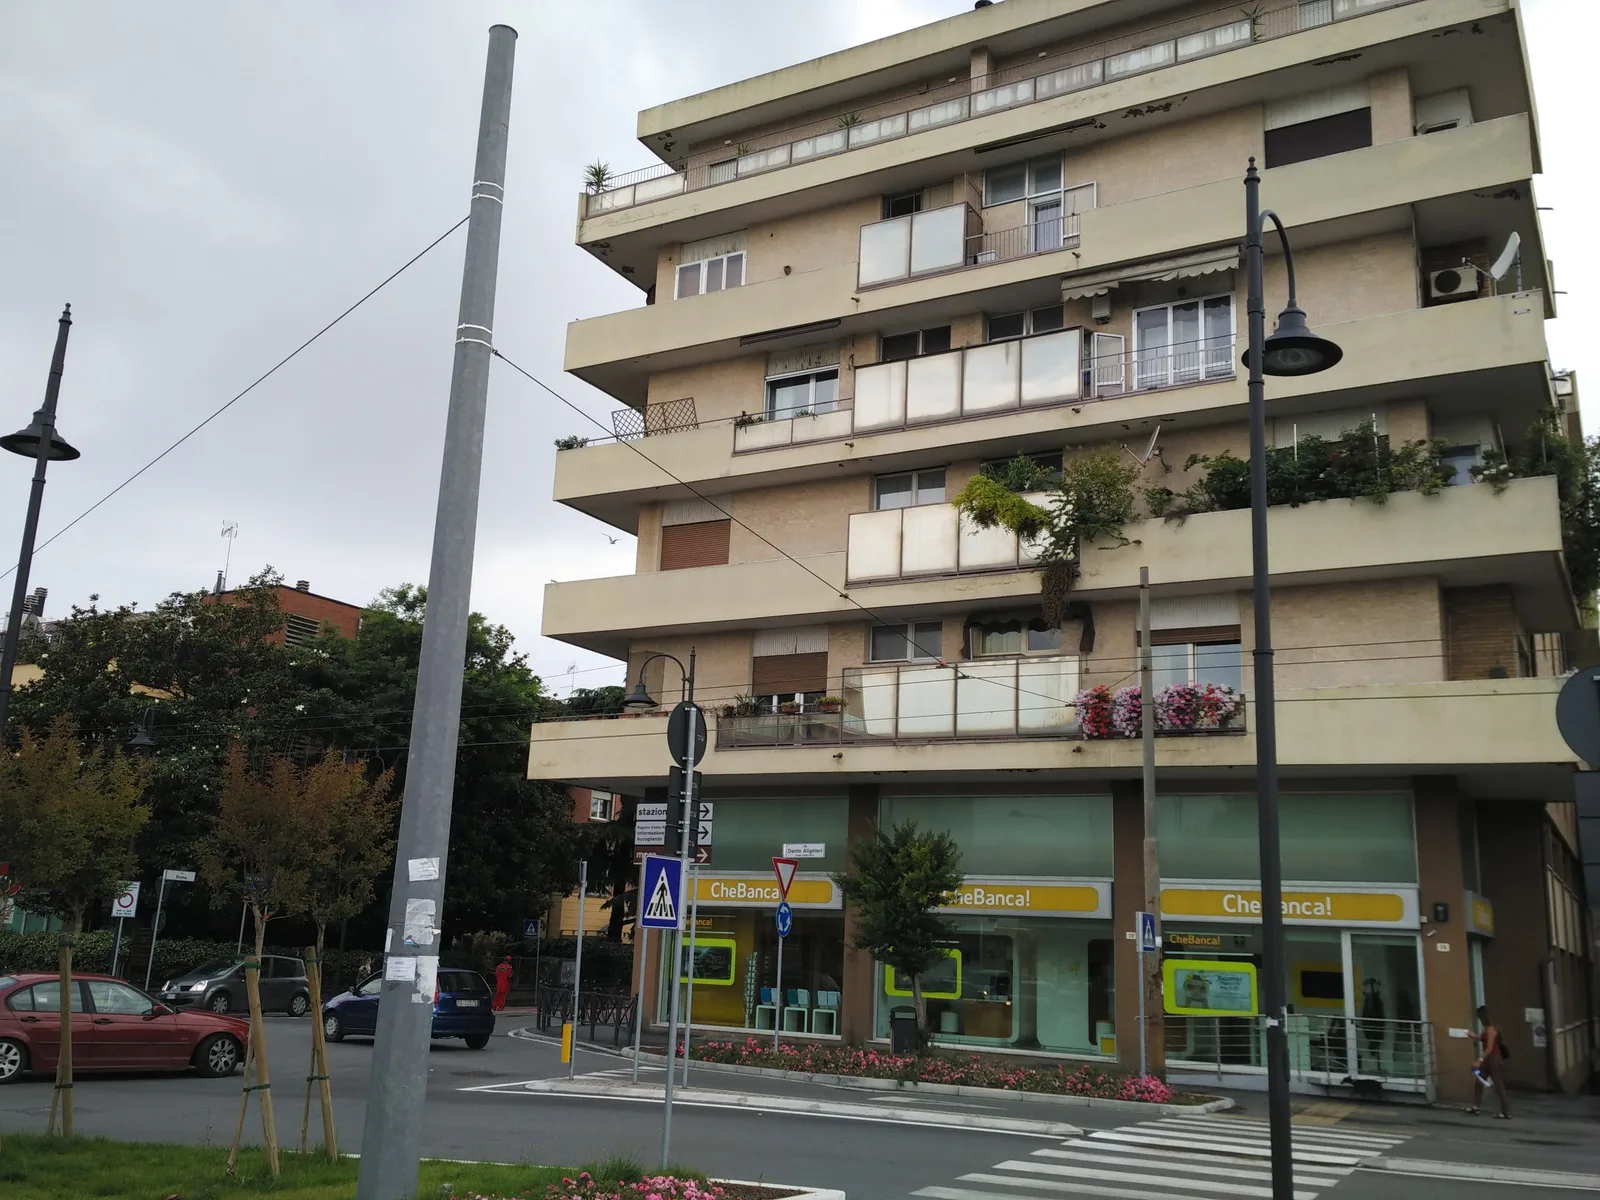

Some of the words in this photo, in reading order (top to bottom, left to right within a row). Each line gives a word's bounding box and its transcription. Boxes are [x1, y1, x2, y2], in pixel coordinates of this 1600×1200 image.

[638, 807, 668, 816] stazion
[710, 881, 780, 899] CheBanca
[1222, 893, 1332, 916] Cheanca!
[1169, 934, 1221, 946] CheBanca!
